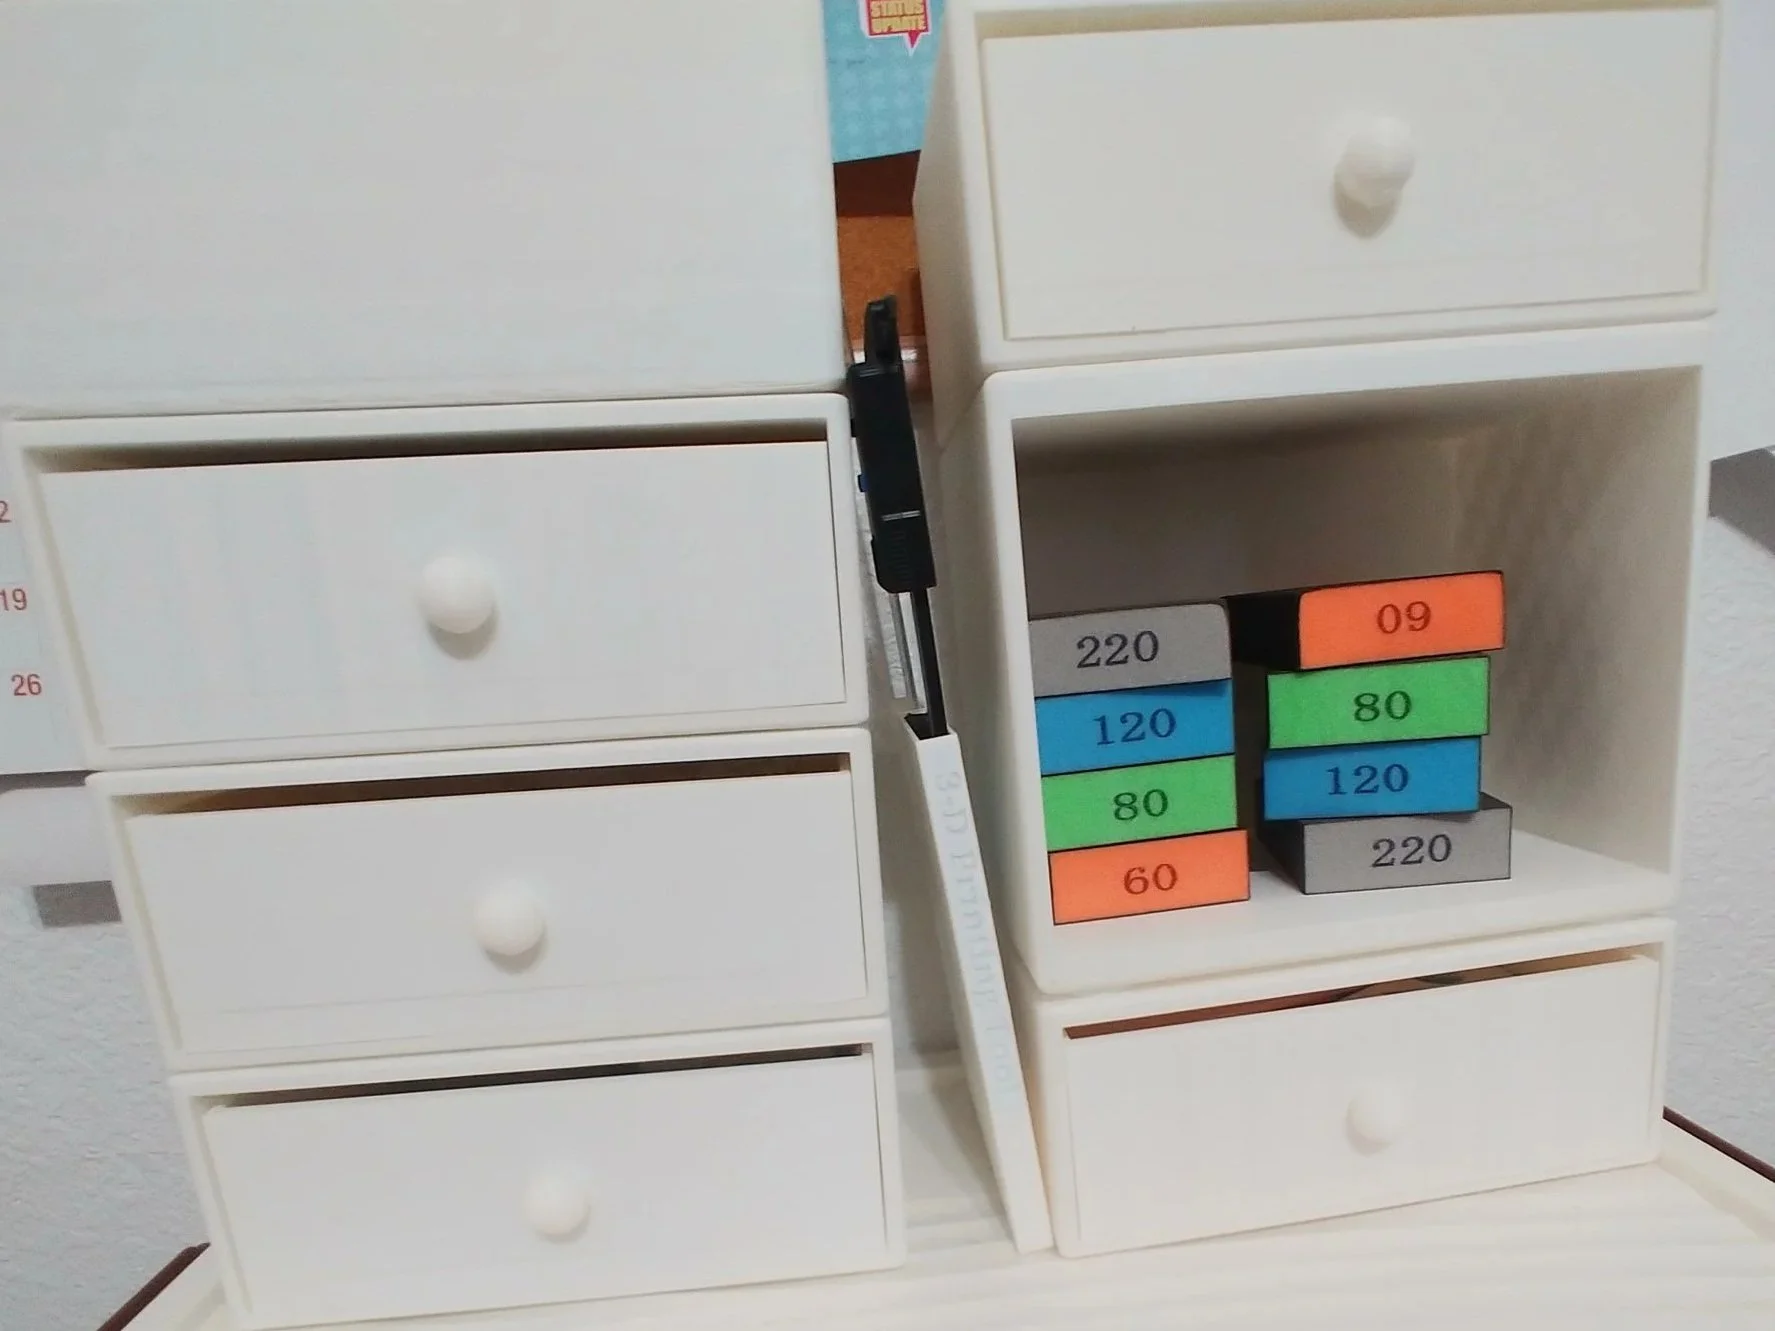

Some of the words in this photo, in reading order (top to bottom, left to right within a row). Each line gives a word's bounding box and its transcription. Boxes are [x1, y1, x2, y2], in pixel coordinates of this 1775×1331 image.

[0, 587, 28, 612] 19
[1076, 630, 1160, 669] 220
[11, 673, 42, 697] 26
[1353, 690, 1412, 722] 80
[1093, 708, 1177, 746] 120
[1326, 763, 1409, 795] 120
[1113, 788, 1169, 821] 80
[1371, 833, 1452, 868] 220
[1123, 863, 1178, 895] 60
